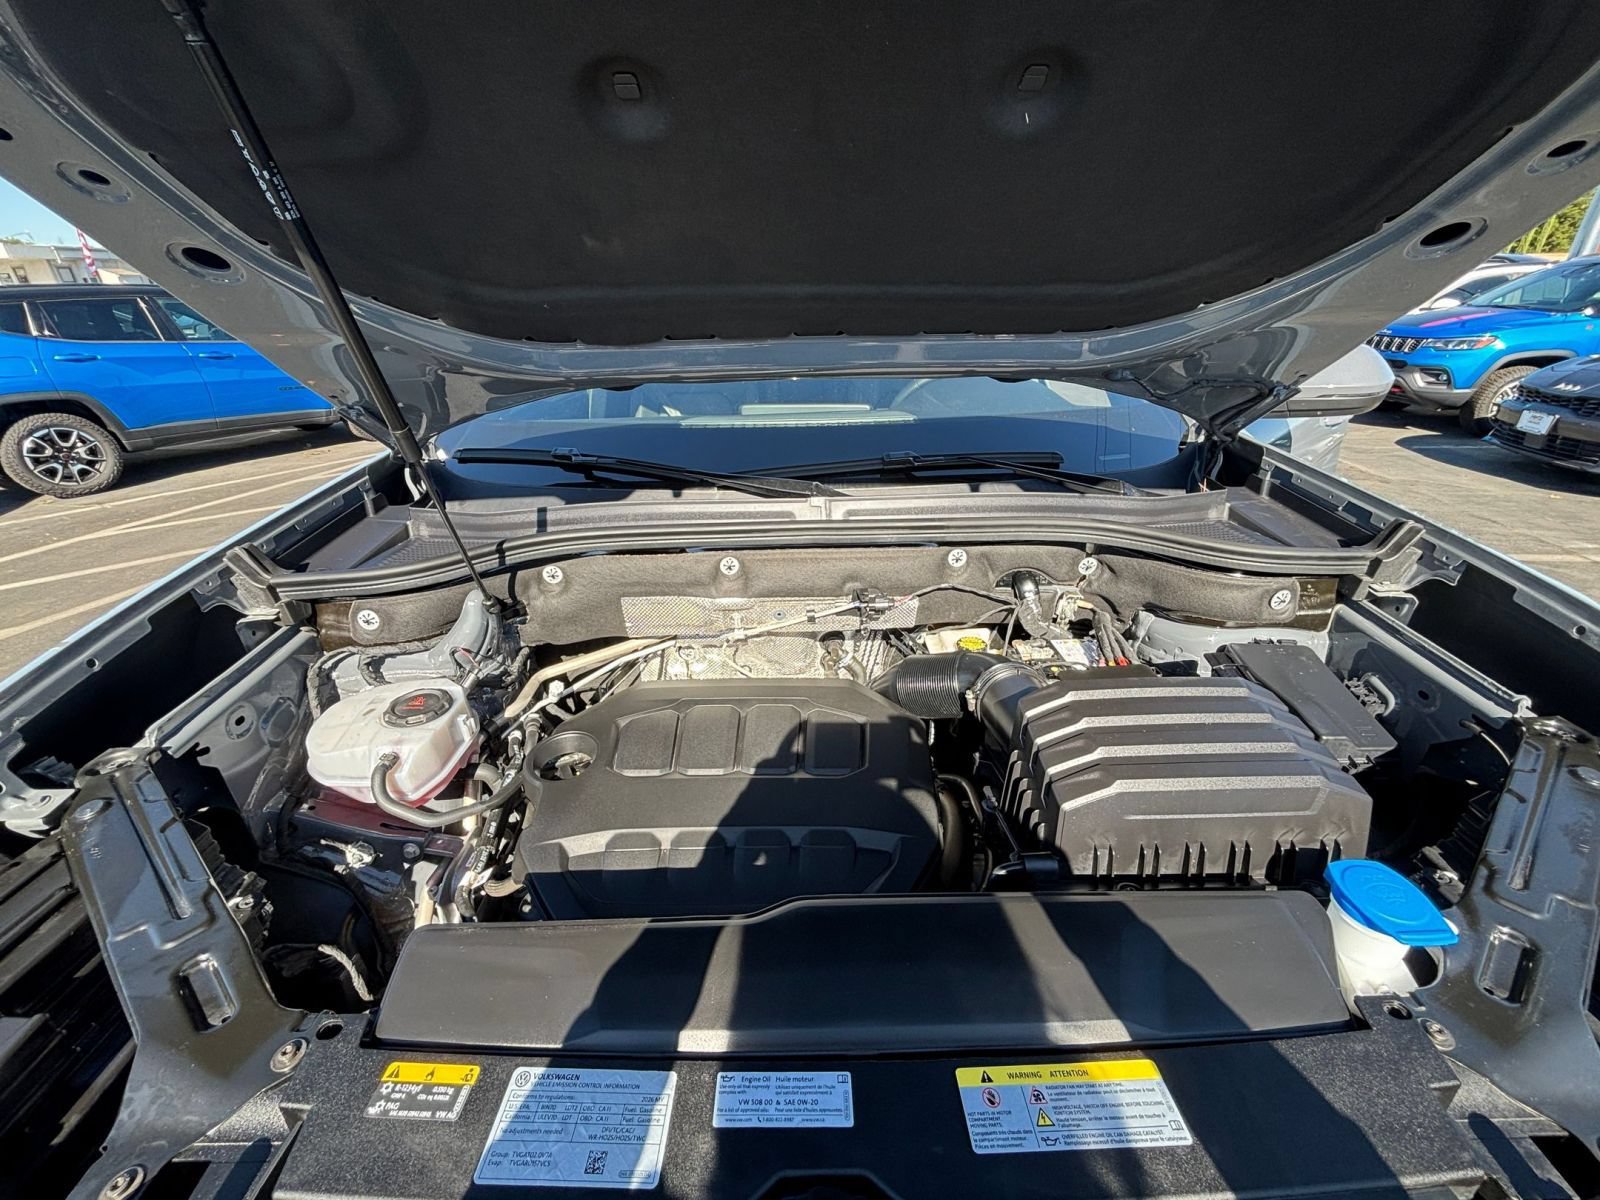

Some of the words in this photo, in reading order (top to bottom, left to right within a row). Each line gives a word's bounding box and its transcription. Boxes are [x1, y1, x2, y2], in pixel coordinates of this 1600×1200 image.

[532, 1072, 580, 1081] VOLKSWAGEN
[1007, 1071, 1042, 1079] WARNING
[1050, 1069, 1088, 1078] ATTENTION
